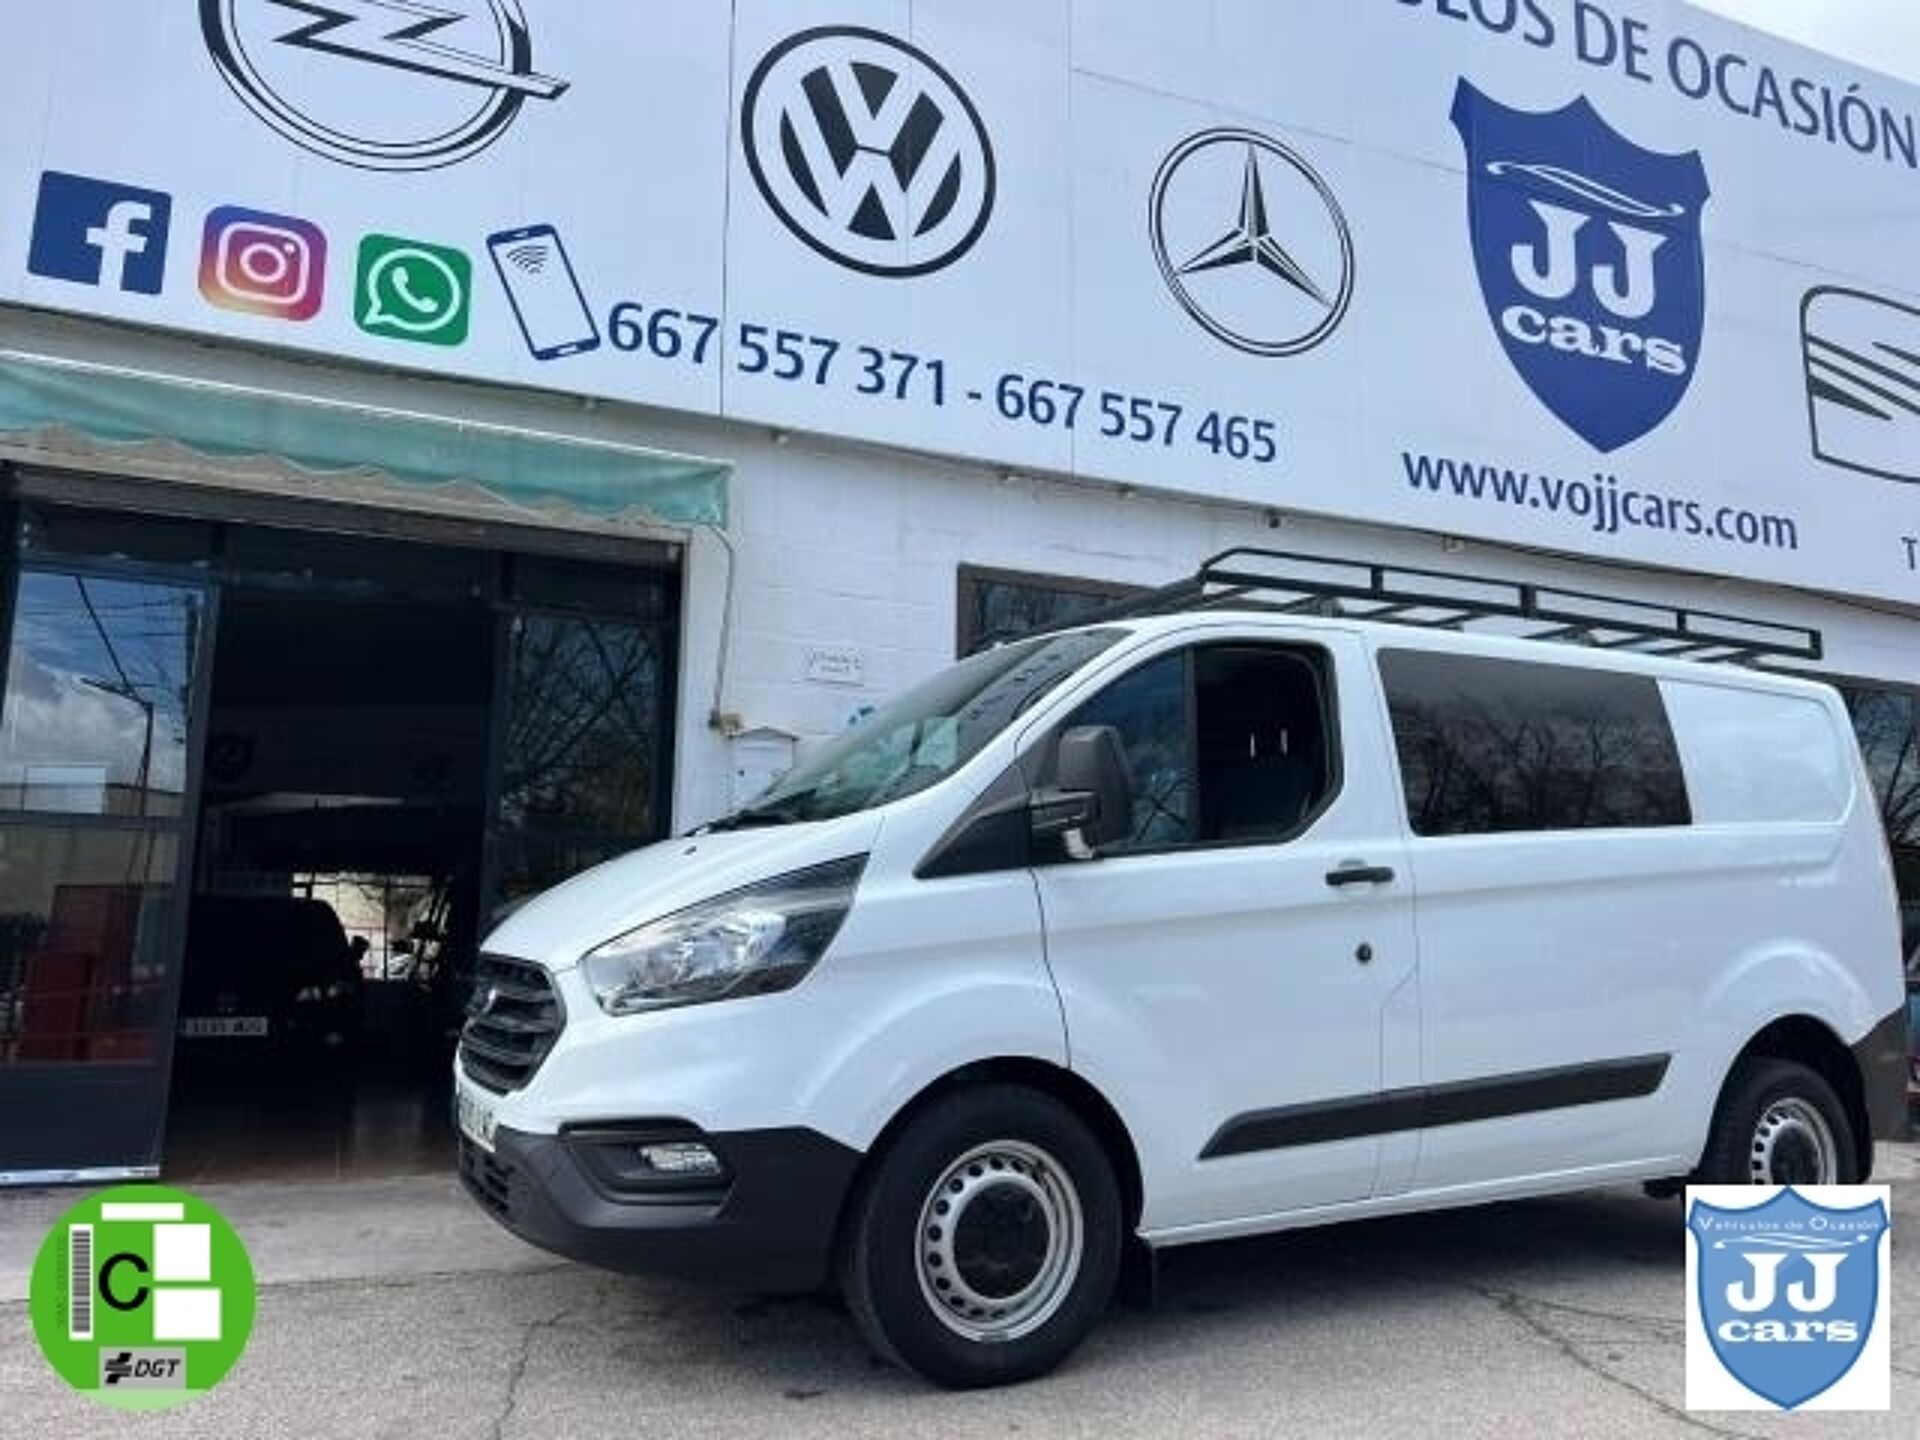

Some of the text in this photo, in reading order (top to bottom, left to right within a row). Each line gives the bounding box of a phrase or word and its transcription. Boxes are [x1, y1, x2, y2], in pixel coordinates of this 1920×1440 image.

[1574, 0, 1653, 83] DE
[1666, 37, 1918, 169] OCASIÓN
[1511, 200, 1669, 319] JJ
[607, 302, 718, 365] 667
[737, 323, 840, 385] 557
[856, 346, 944, 406] 371
[996, 374, 1085, 430] 667
[1100, 392, 1183, 446] 557
[1196, 411, 1276, 463] 465
[1502, 305, 1687, 375] cars
[1401, 452, 1799, 550] www.vojjcars.com
